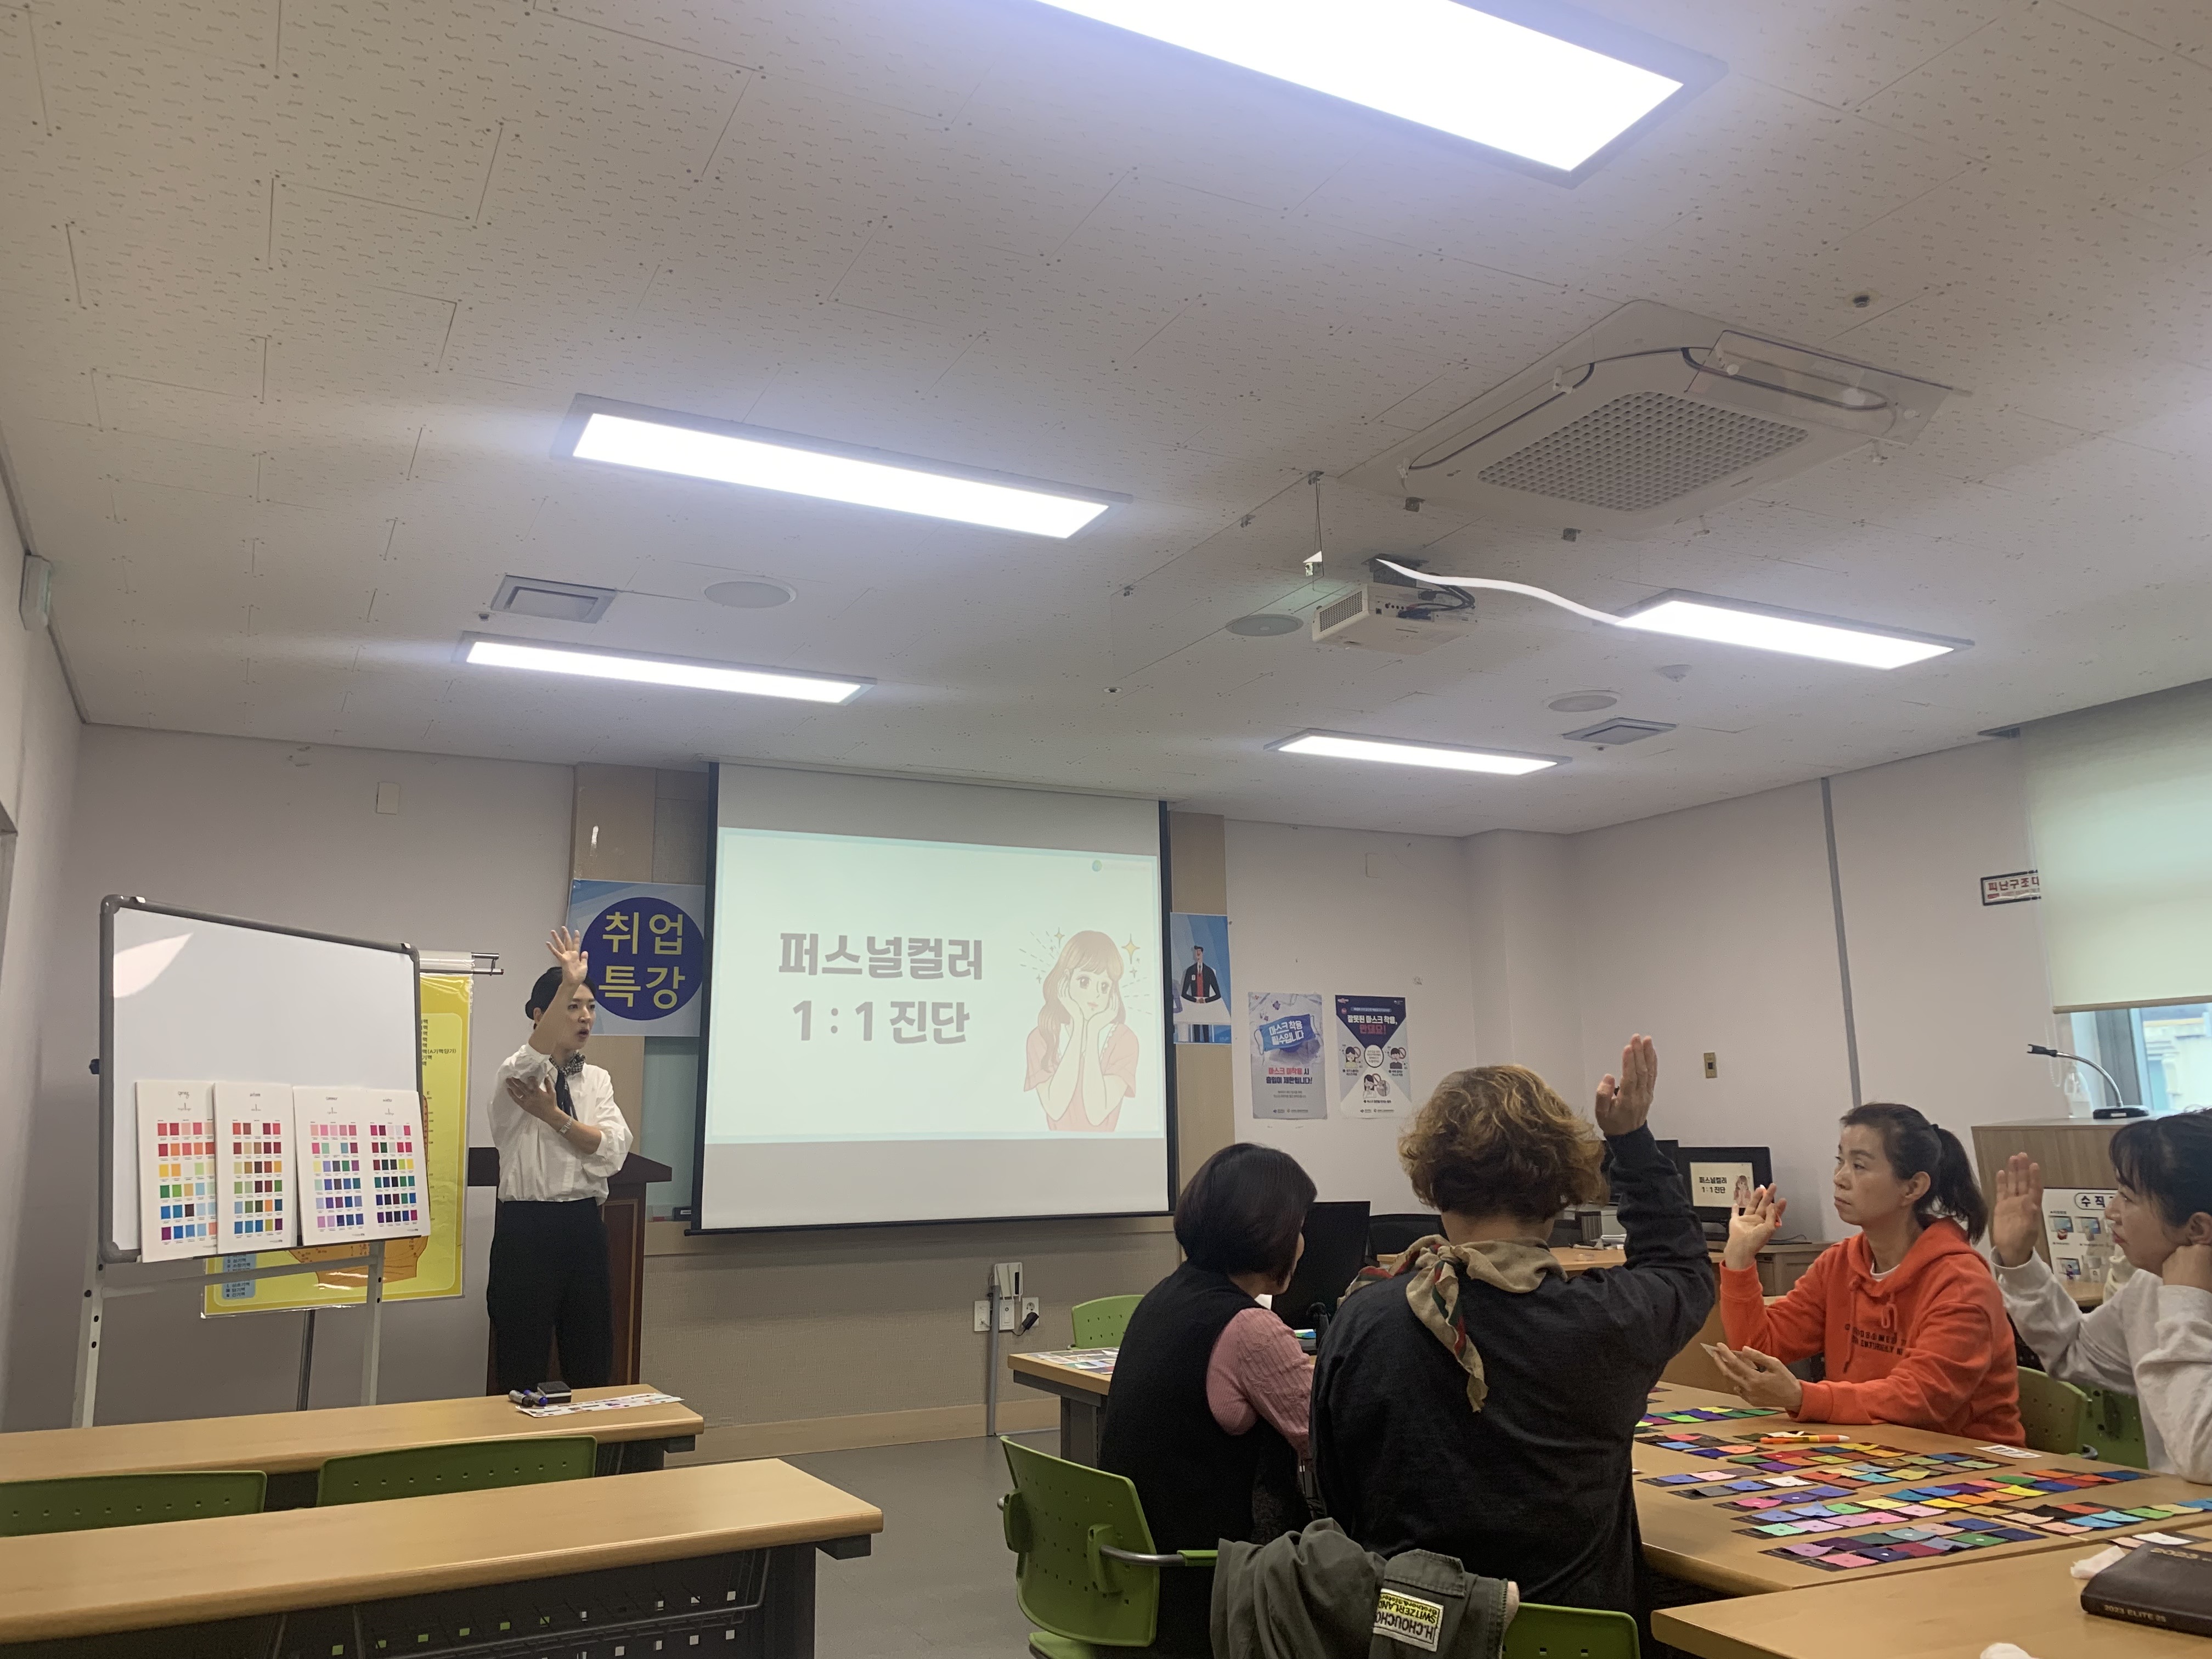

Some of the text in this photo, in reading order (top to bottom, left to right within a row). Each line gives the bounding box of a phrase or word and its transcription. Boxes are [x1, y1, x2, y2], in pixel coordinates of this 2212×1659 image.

[602, 912, 684, 955] 취업
[778, 933, 984, 980] 퍼스널컬러
[599, 966, 685, 1009] 특강
[889, 1001, 970, 1044] 진단
[1269, 1020, 1303, 1036] 마스크 착용
[1347, 1015, 1365, 1023] 잘못된
[1366, 1015, 1383, 1024] 마스크
[1272, 1030, 1304, 1045] 필수입니다
[2081, 1195, 2114, 1208] 수직
